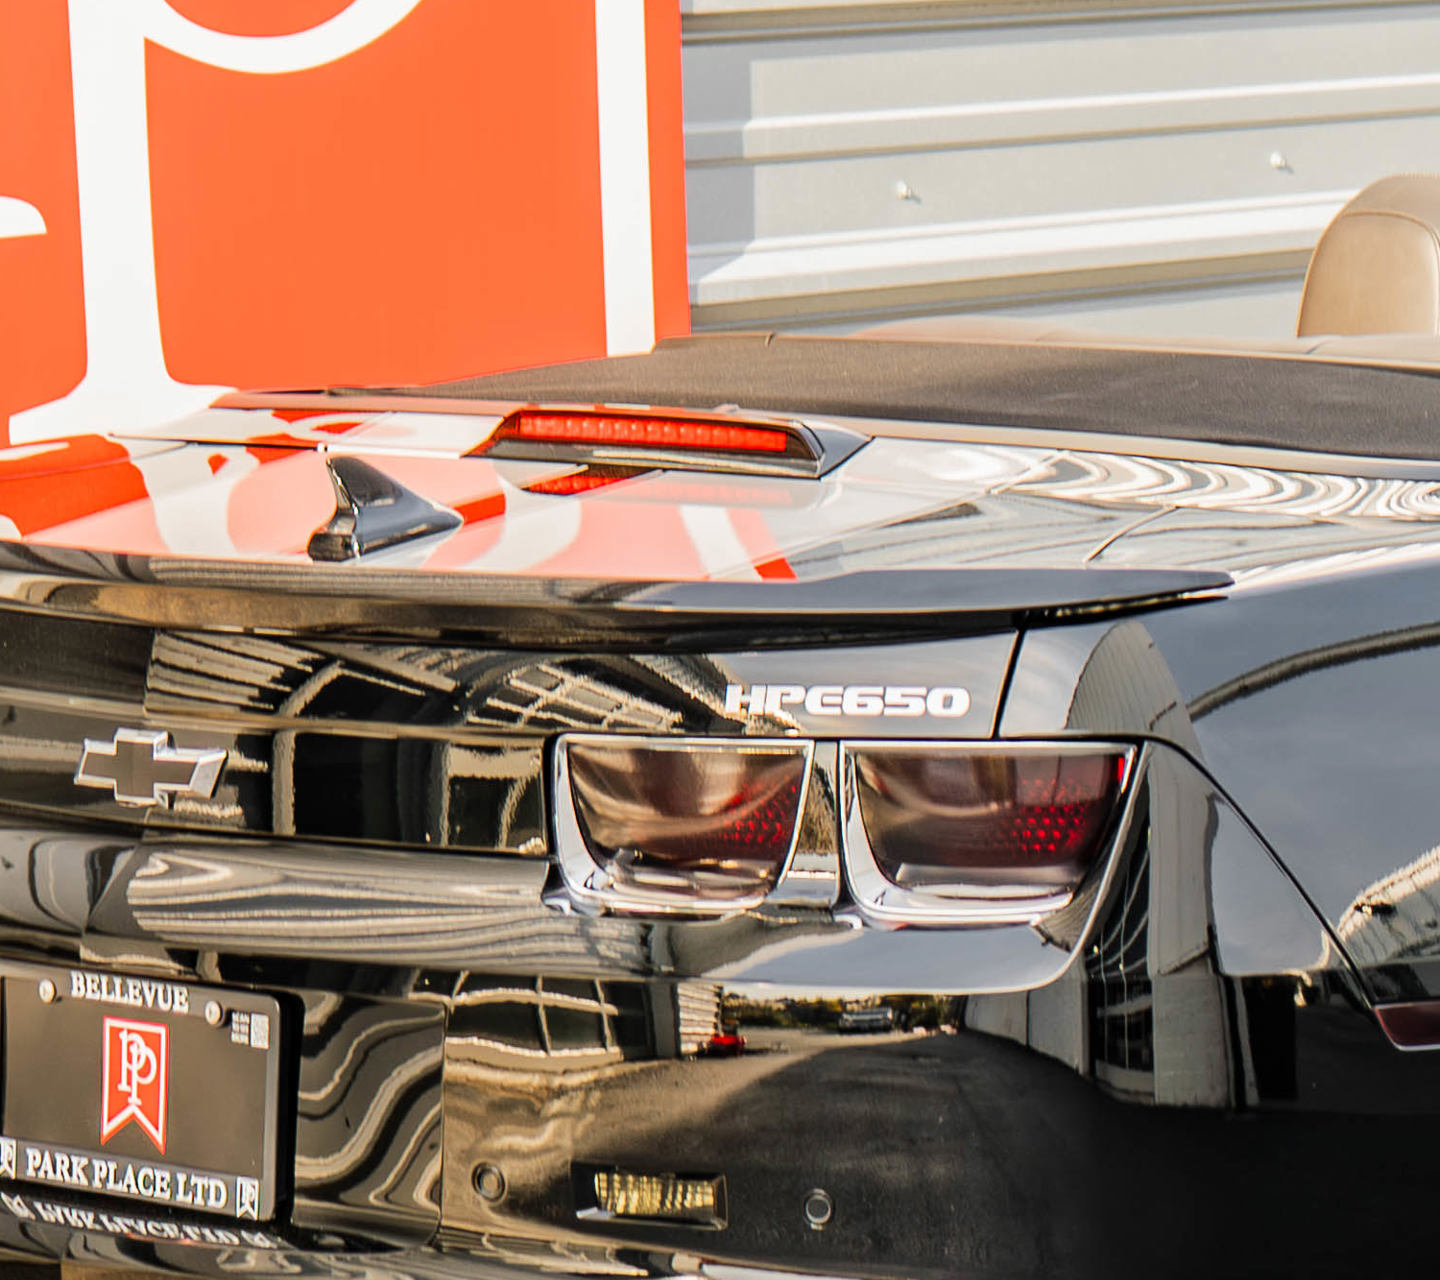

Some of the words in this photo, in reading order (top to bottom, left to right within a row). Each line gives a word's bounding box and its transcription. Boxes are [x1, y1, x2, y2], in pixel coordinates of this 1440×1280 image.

[724, 683, 971, 718] HPE650
[70, 970, 189, 1014] BELLEVUE
[26, 1147, 89, 1187] PARK
[92, 1158, 171, 1201] PLACE
[175, 1172, 228, 1209] LTD
